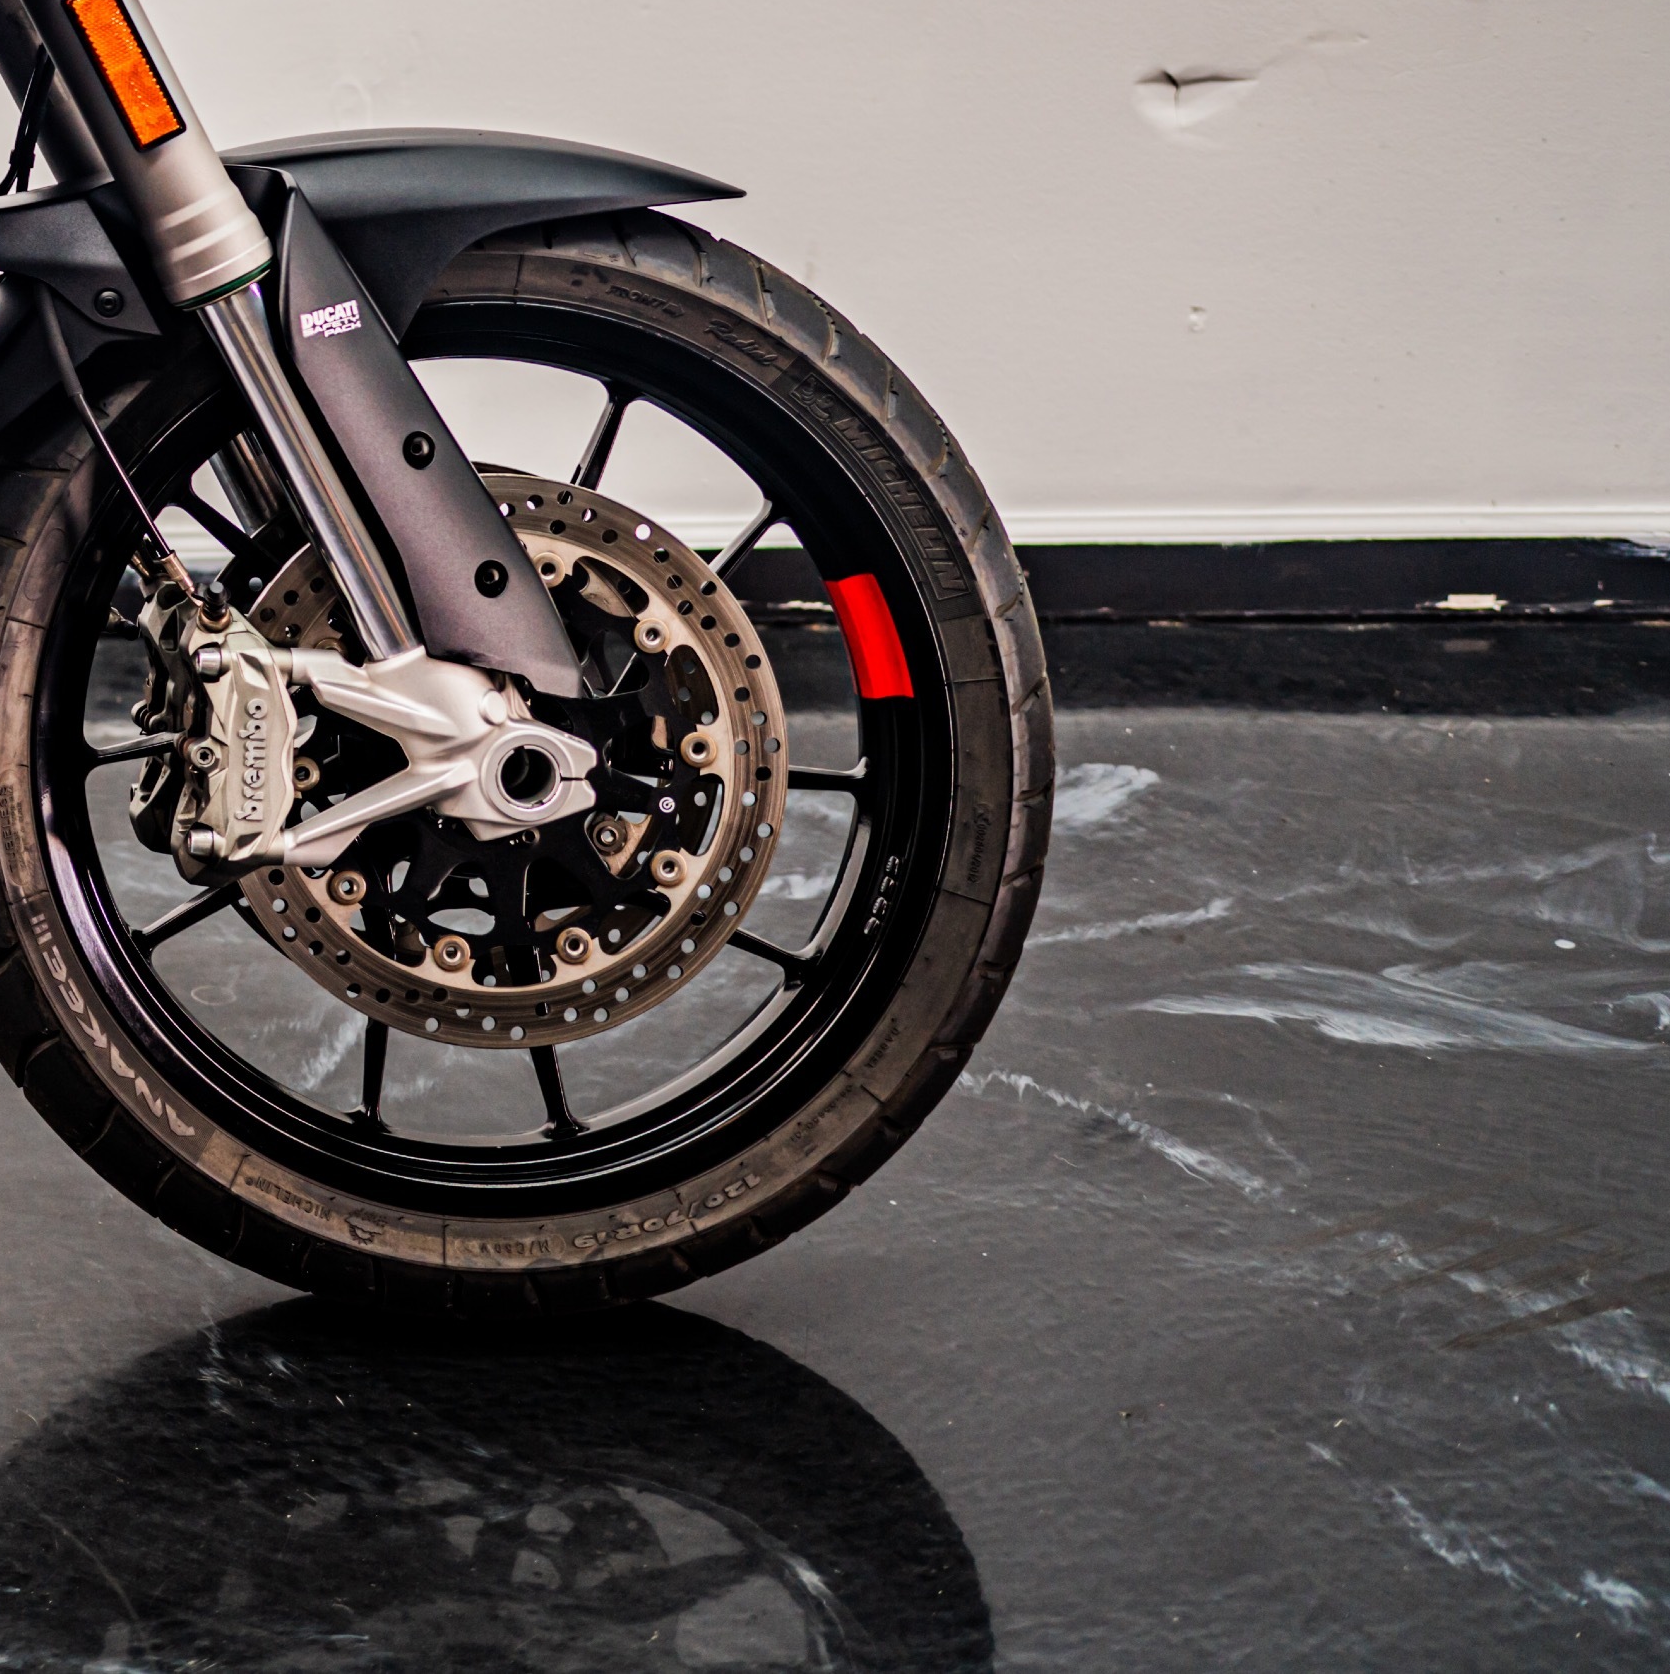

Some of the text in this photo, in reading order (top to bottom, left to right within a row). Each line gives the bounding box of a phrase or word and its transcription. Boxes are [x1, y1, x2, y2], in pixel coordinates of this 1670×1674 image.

[300, 300, 358, 330] DUCATI
[302, 314, 360, 338] SAFETY
[324, 321, 362, 338] PACK
[705, 318, 778, 367] Radial
[835, 412, 964, 596] MICHELIN
[236, 699, 268, 822] brembo
[31, 915, 195, 1136] ANAKEE III
